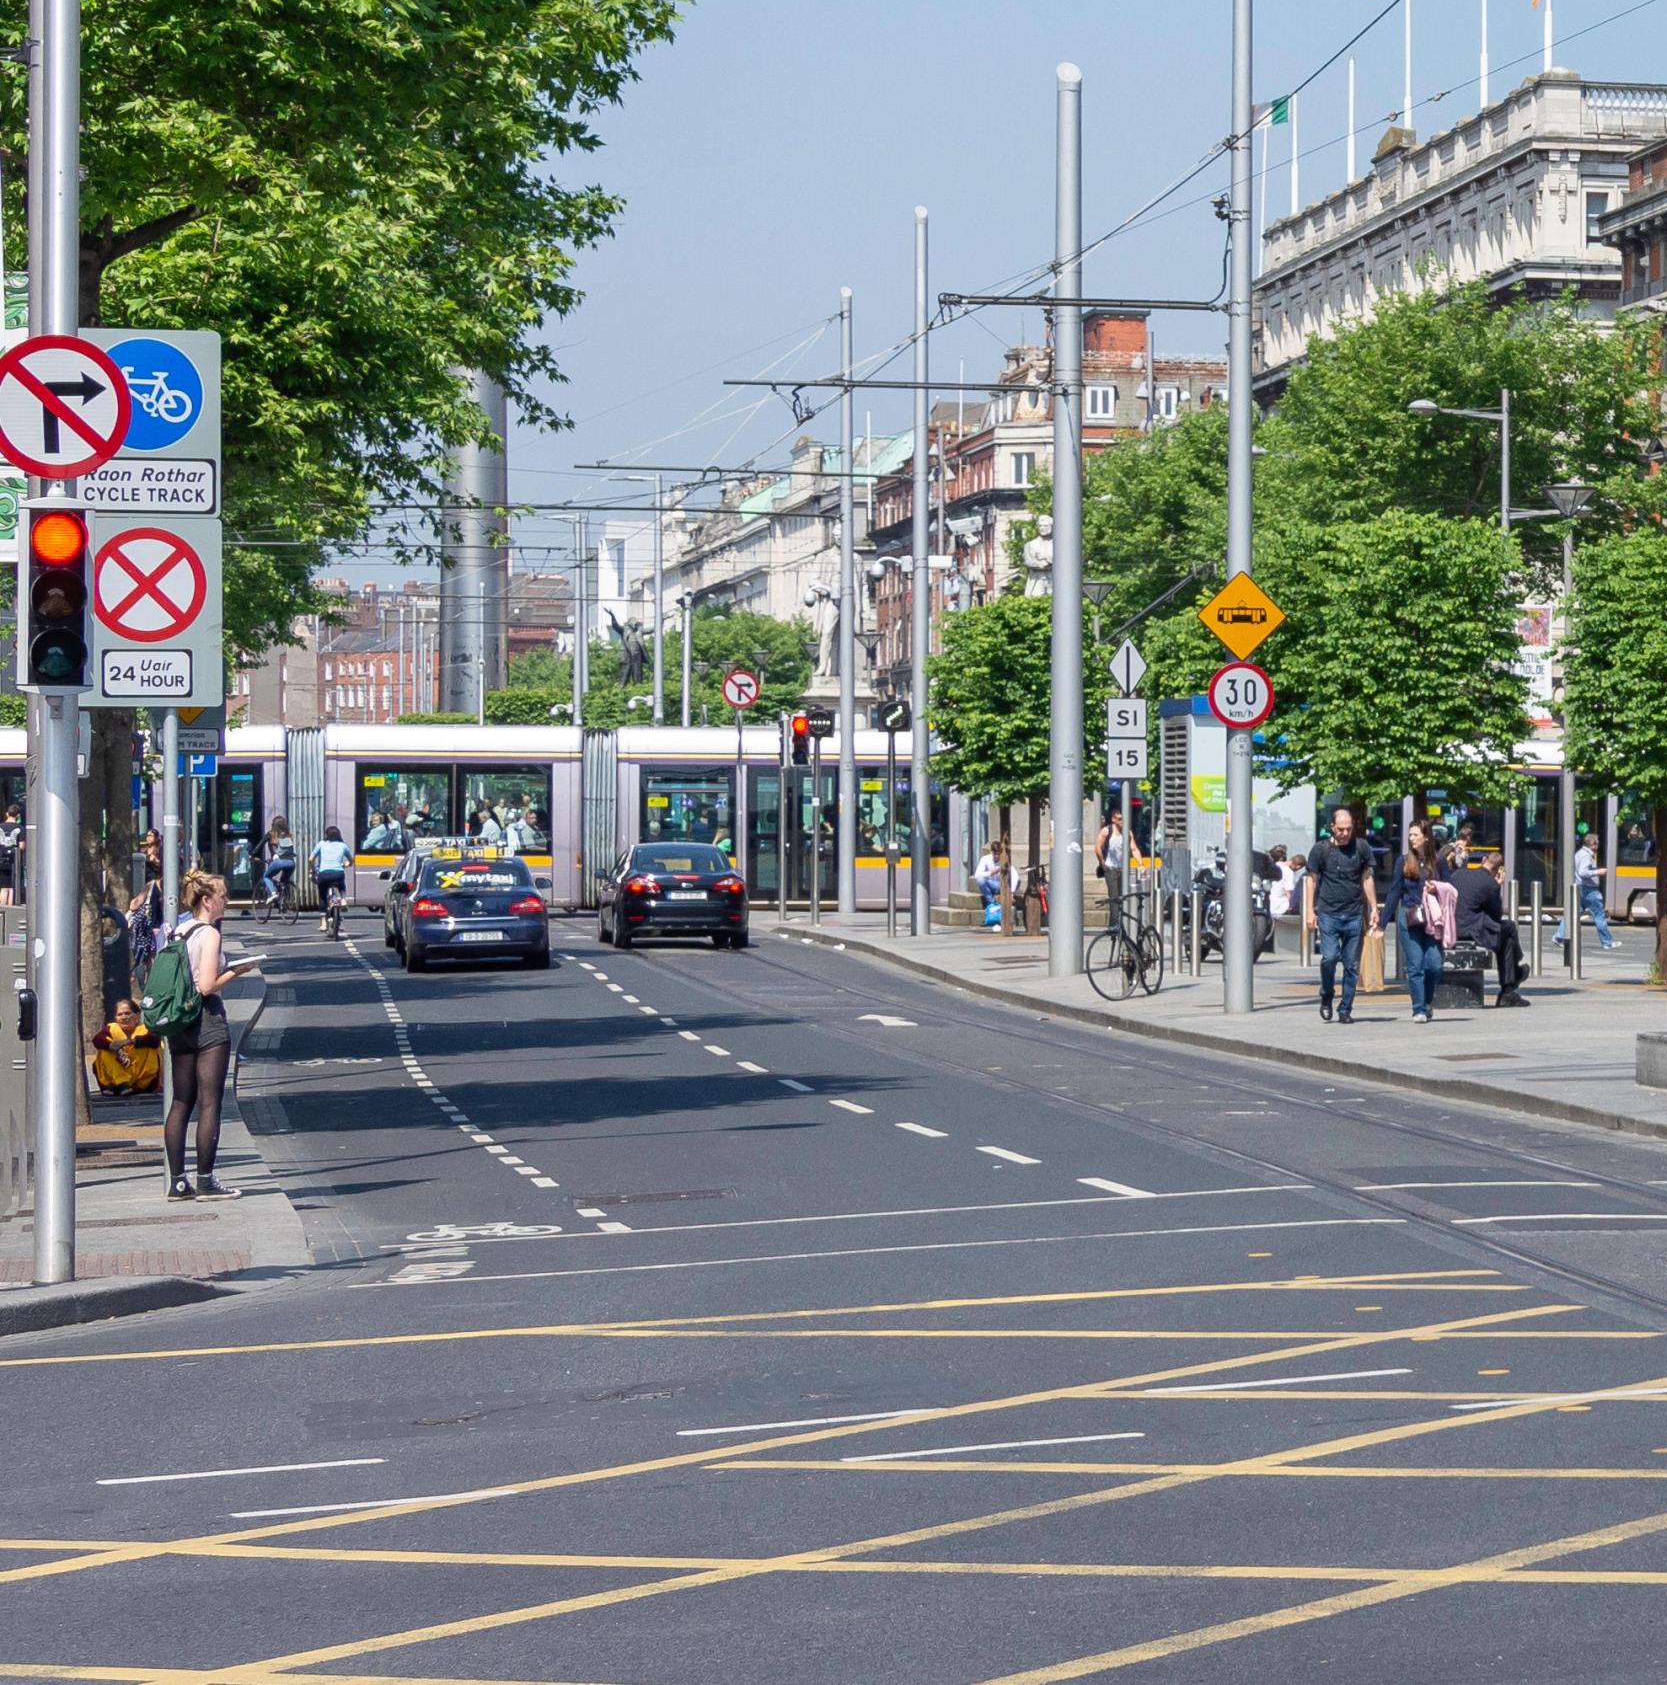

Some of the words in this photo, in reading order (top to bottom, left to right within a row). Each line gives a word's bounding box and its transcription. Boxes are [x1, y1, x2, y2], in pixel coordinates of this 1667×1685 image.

[141, 467, 206, 483] Rothar
[84, 486, 140, 502] CYCLE
[147, 488, 206, 503] TRACK
[141, 658, 173, 672] Uair
[109, 665, 136, 682] 24
[140, 675, 185, 688] HOUR
[1225, 678, 1258, 706] 30
[1228, 708, 1254, 719] km/h
[187, 741, 216, 749] TRACK
[1116, 749, 1139, 767] 15
[446, 838, 466, 847] TAXI
[464, 849, 485, 860] TAXI
[460, 873, 514, 886] mytaxi
